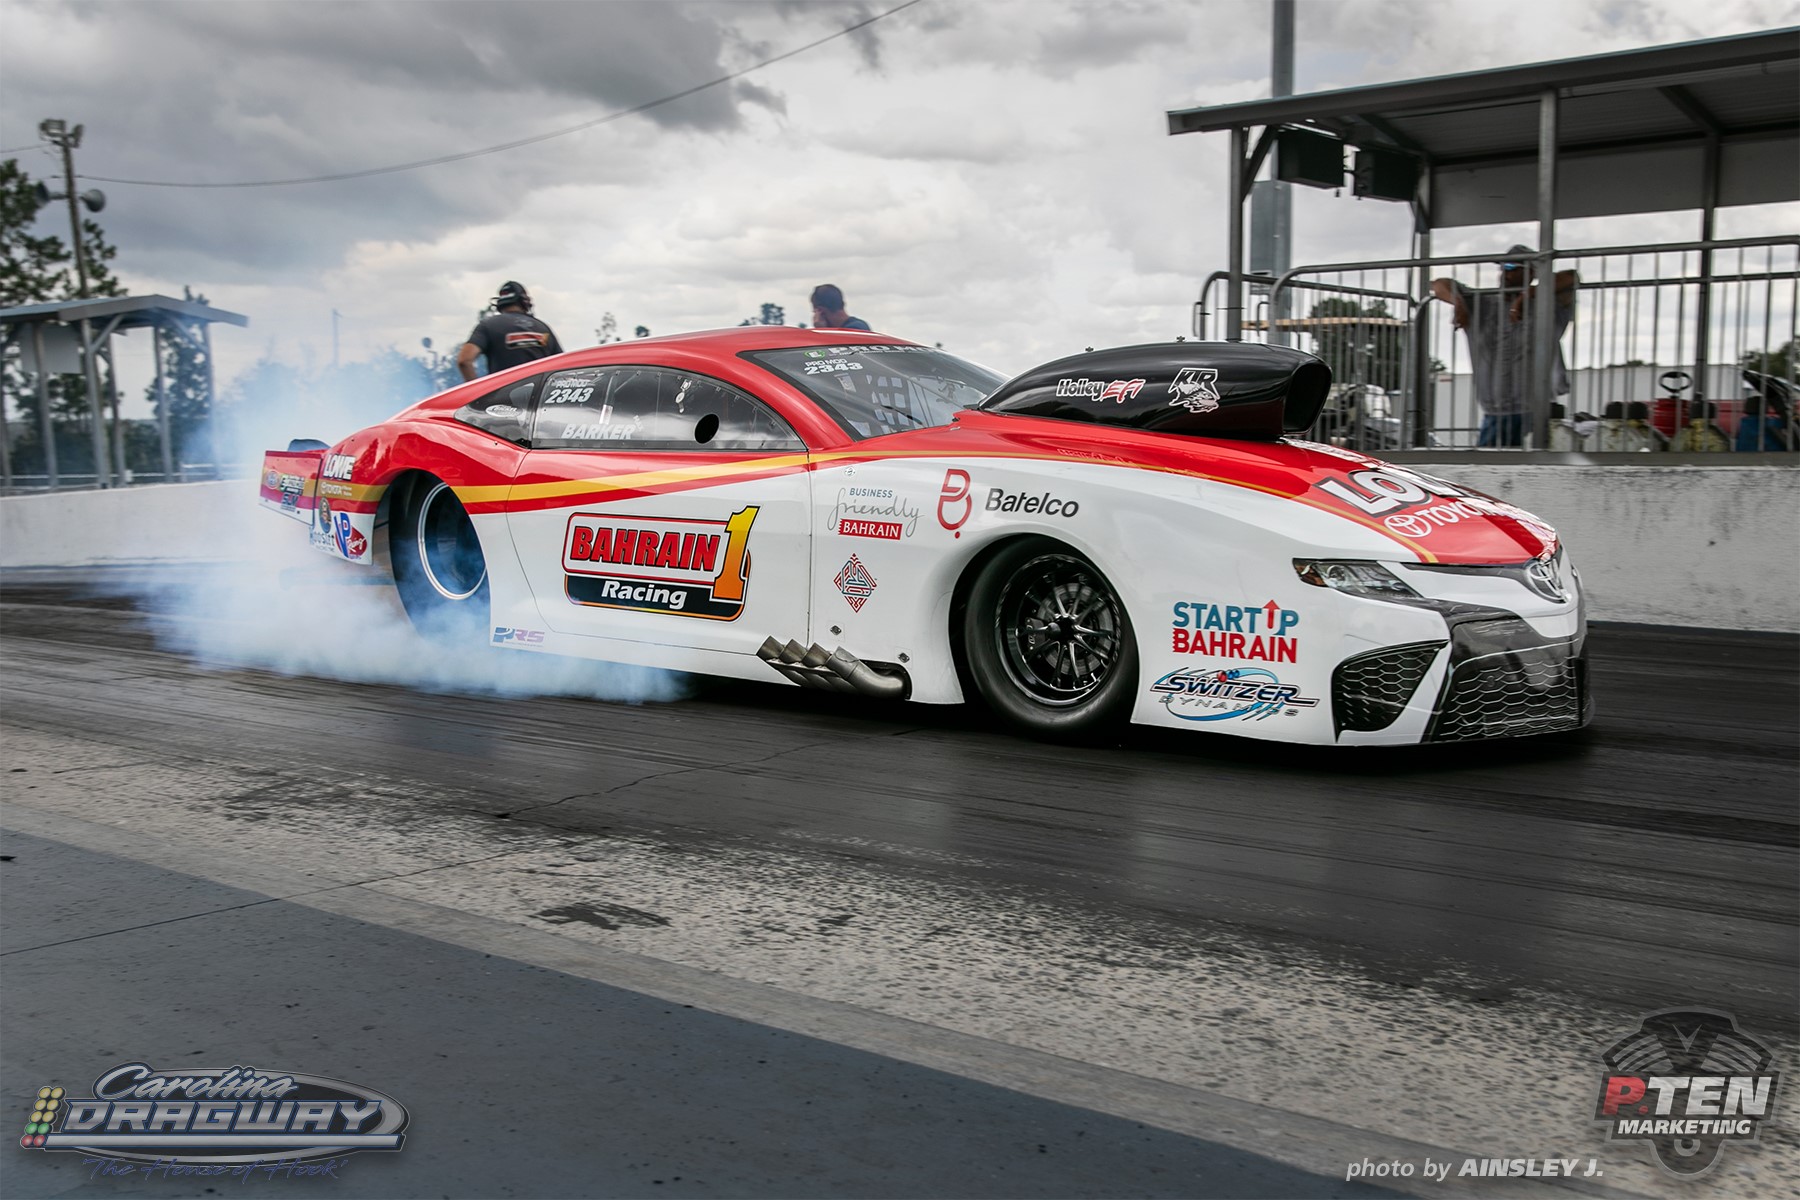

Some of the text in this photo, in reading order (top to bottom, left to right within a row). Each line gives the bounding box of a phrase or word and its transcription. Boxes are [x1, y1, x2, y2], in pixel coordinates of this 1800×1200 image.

[804, 362, 863, 375] 2343
[544, 387, 594, 404] 2343
[1056, 378, 1146, 403] Holley EFI
[560, 423, 637, 440] BARKER
[323, 453, 356, 481] LOWE
[850, 487, 893, 499] BUSINESS
[985, 488, 1079, 518] Batelco
[827, 487, 925, 538] friendly
[842, 520, 900, 538] BAHRAIN
[570, 505, 760, 600] BAHRAIN 1
[601, 580, 687, 610] Racing
[1172, 628, 1298, 664] BAHRAIN
[1150, 674, 1320, 707] SWITZER
